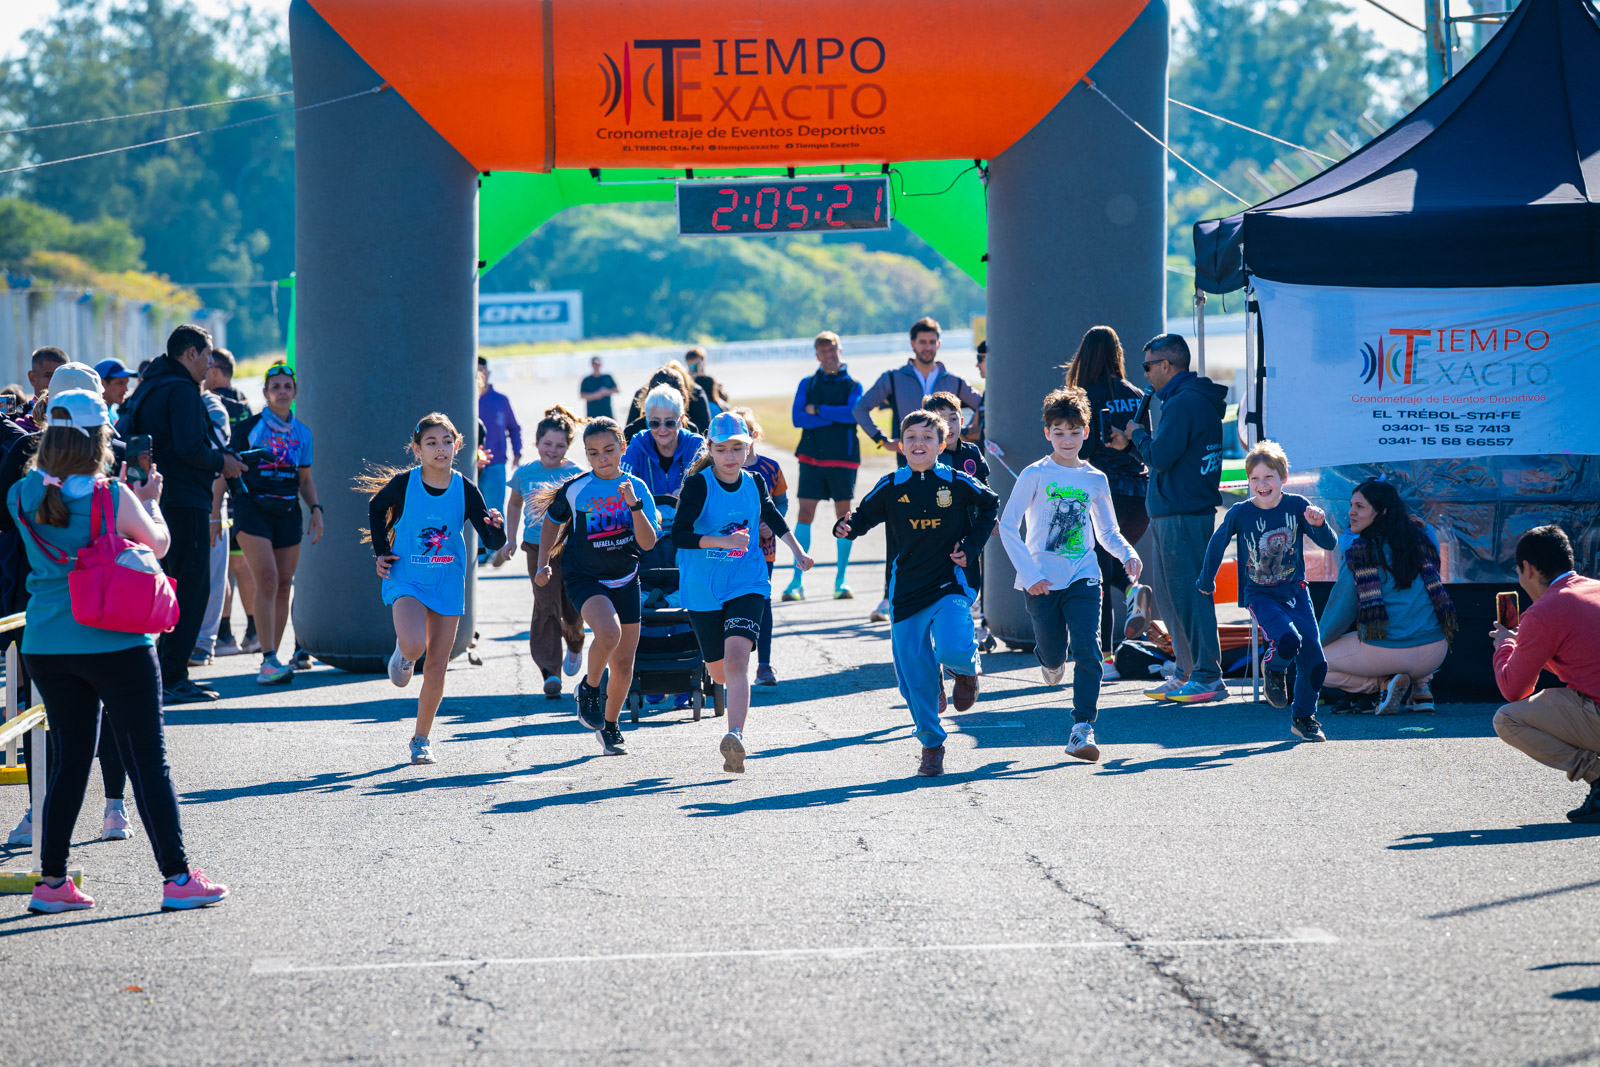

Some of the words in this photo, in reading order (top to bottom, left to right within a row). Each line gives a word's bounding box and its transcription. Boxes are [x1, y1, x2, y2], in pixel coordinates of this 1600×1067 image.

[596, 127, 703, 141] Cronometraje
[707, 126, 727, 138] de
[731, 126, 793, 138] Eventos
[798, 124, 886, 138] Deportivos
[711, 184, 884, 231] 2:05:21
[1351, 394, 1423, 406] Cronometraje
[1425, 395, 1440, 404] de
[1442, 394, 1486, 404] Eventos
[1489, 392, 1546, 404] Deportivos
[1372, 410, 1393, 419] EL
[1396, 408, 1521, 421] TRÉBOL-STA-FE
[1381, 423, 1431, 432] 03401-
[1434, 423, 1450, 433] 15
[1454, 424, 1474, 433] 52
[1478, 424, 1511, 433] 7413
[1378, 436, 1417, 446] 0341-
[1421, 437, 1437, 446] 15
[1440, 437, 1462, 446] 68
[1465, 437, 1514, 447] 66557
[908, 518, 942, 530] YPF
